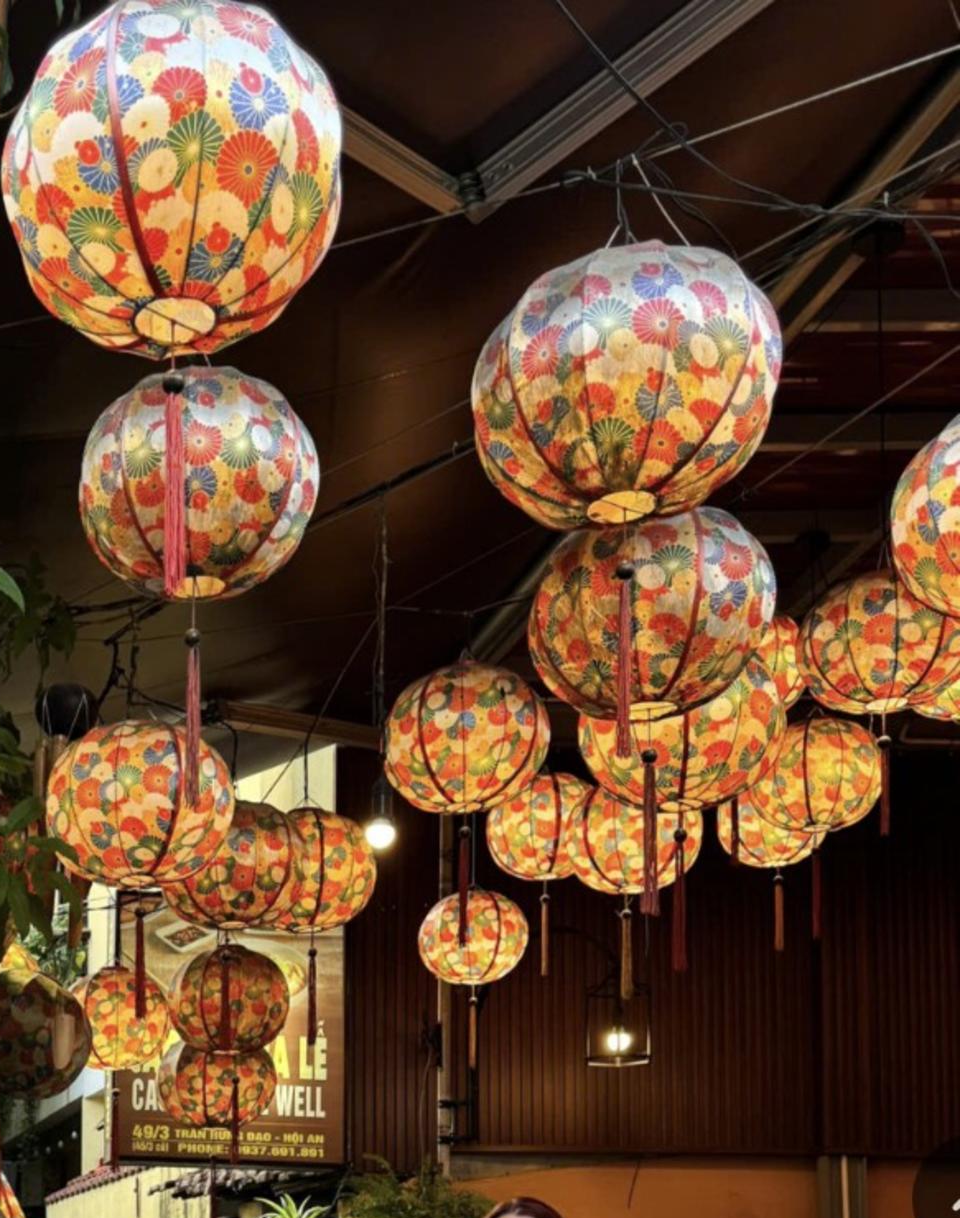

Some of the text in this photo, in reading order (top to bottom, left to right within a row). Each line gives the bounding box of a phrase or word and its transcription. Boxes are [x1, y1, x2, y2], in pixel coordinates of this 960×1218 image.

[275, 1084, 326, 1118] WELL
[132, 1124, 170, 1140] 49/3
[307, 1133, 324, 1144] AN
[177, 1143, 230, 1154] PHONE:
